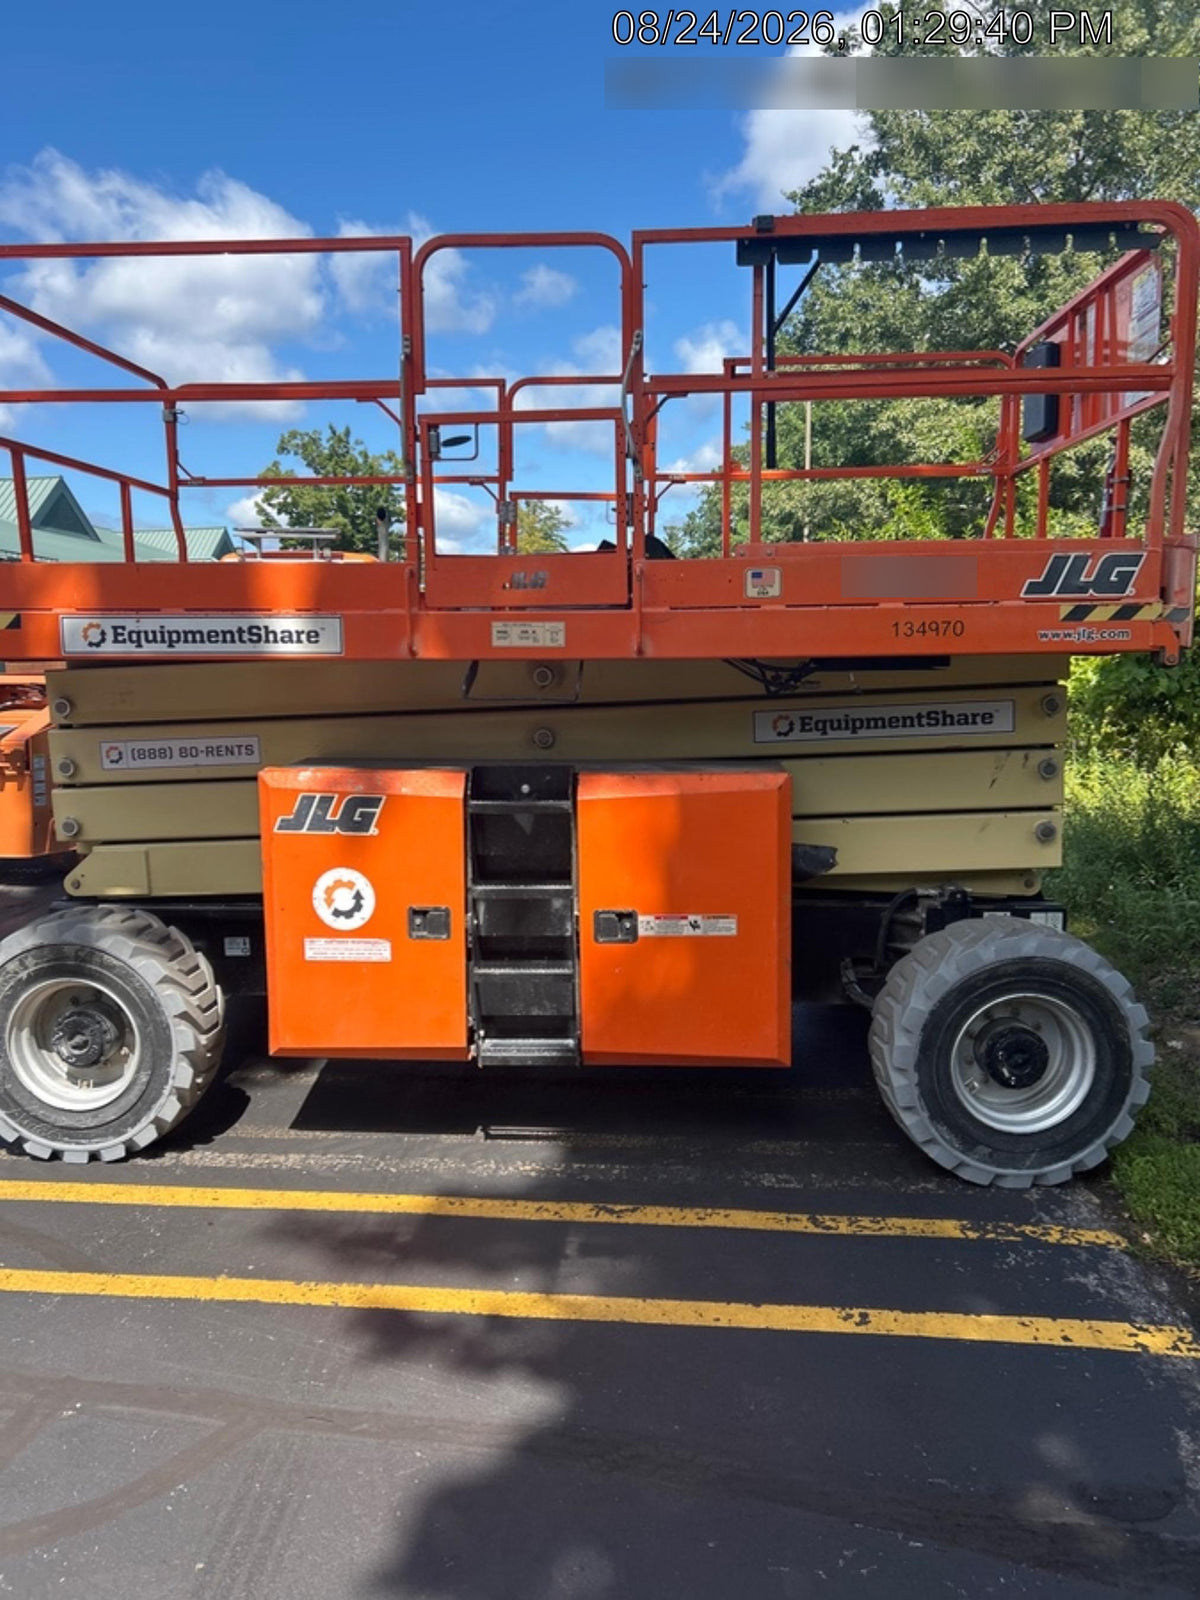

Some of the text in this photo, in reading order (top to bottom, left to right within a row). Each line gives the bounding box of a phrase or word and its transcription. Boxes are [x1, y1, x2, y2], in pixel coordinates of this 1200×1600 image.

[1020, 552, 1147, 598] JLG
[112, 626, 321, 649] EquipmentShare
[892, 620, 966, 638] 134970
[1037, 627, 1131, 643] www.jlg.com
[799, 709, 994, 735] EquipmentShare
[131, 743, 255, 761] (888) 80-RENTS
[273, 793, 386, 835] JLG
